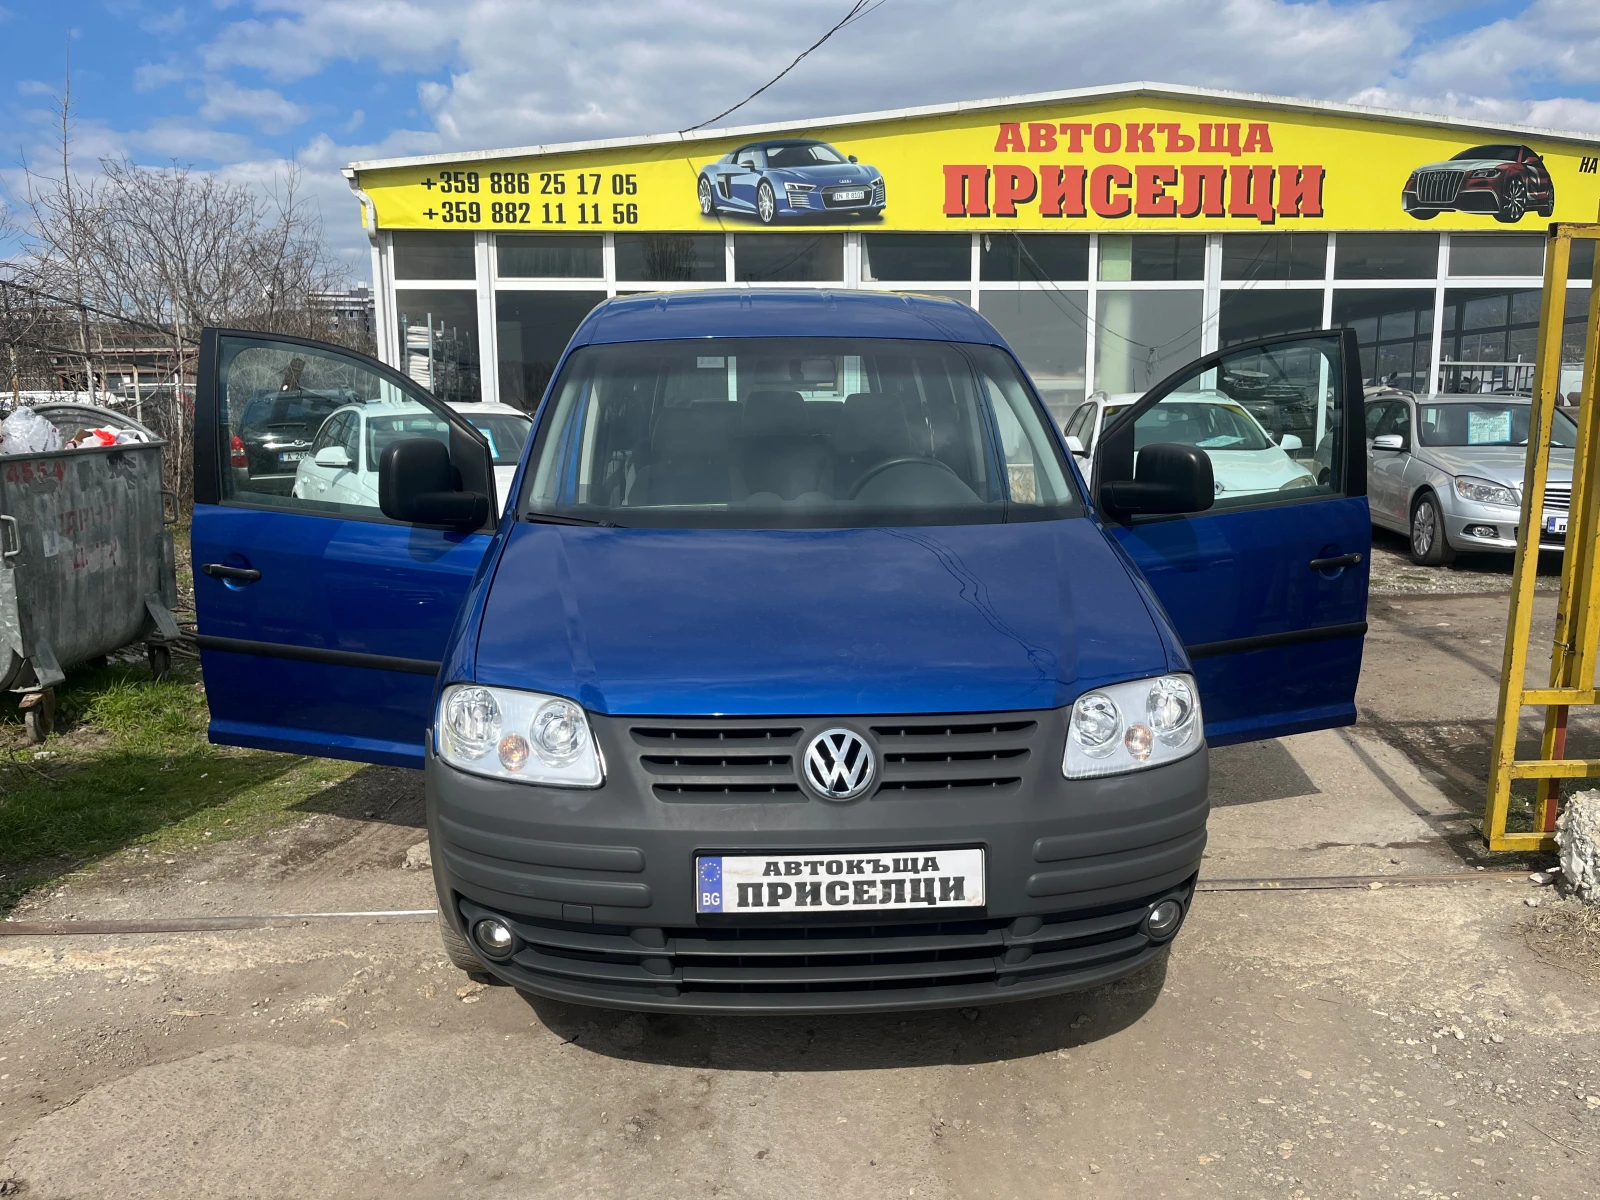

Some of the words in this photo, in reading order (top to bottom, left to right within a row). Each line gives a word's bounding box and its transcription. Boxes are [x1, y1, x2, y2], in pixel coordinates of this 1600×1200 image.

[994, 122, 1274, 157] АВТОКЪЩА
[1579, 156, 1599, 174] НА
[421, 171, 480, 194] +359
[490, 172, 530, 195] 886
[540, 173, 566, 195] 25
[577, 173, 602, 196] 17
[612, 173, 638, 196] 05
[942, 164, 1325, 225] ПРИСЕЛЦИ
[422, 201, 481, 224] +359
[491, 202, 531, 224] 882
[541, 202, 567, 225] 11
[578, 203, 603, 225] 11
[613, 203, 638, 225] 56
[762, 856, 941, 877] АВТОКЪЩА
[702, 891, 720, 906] BG
[736, 876, 966, 908] ПРИСЕЛЦИ
